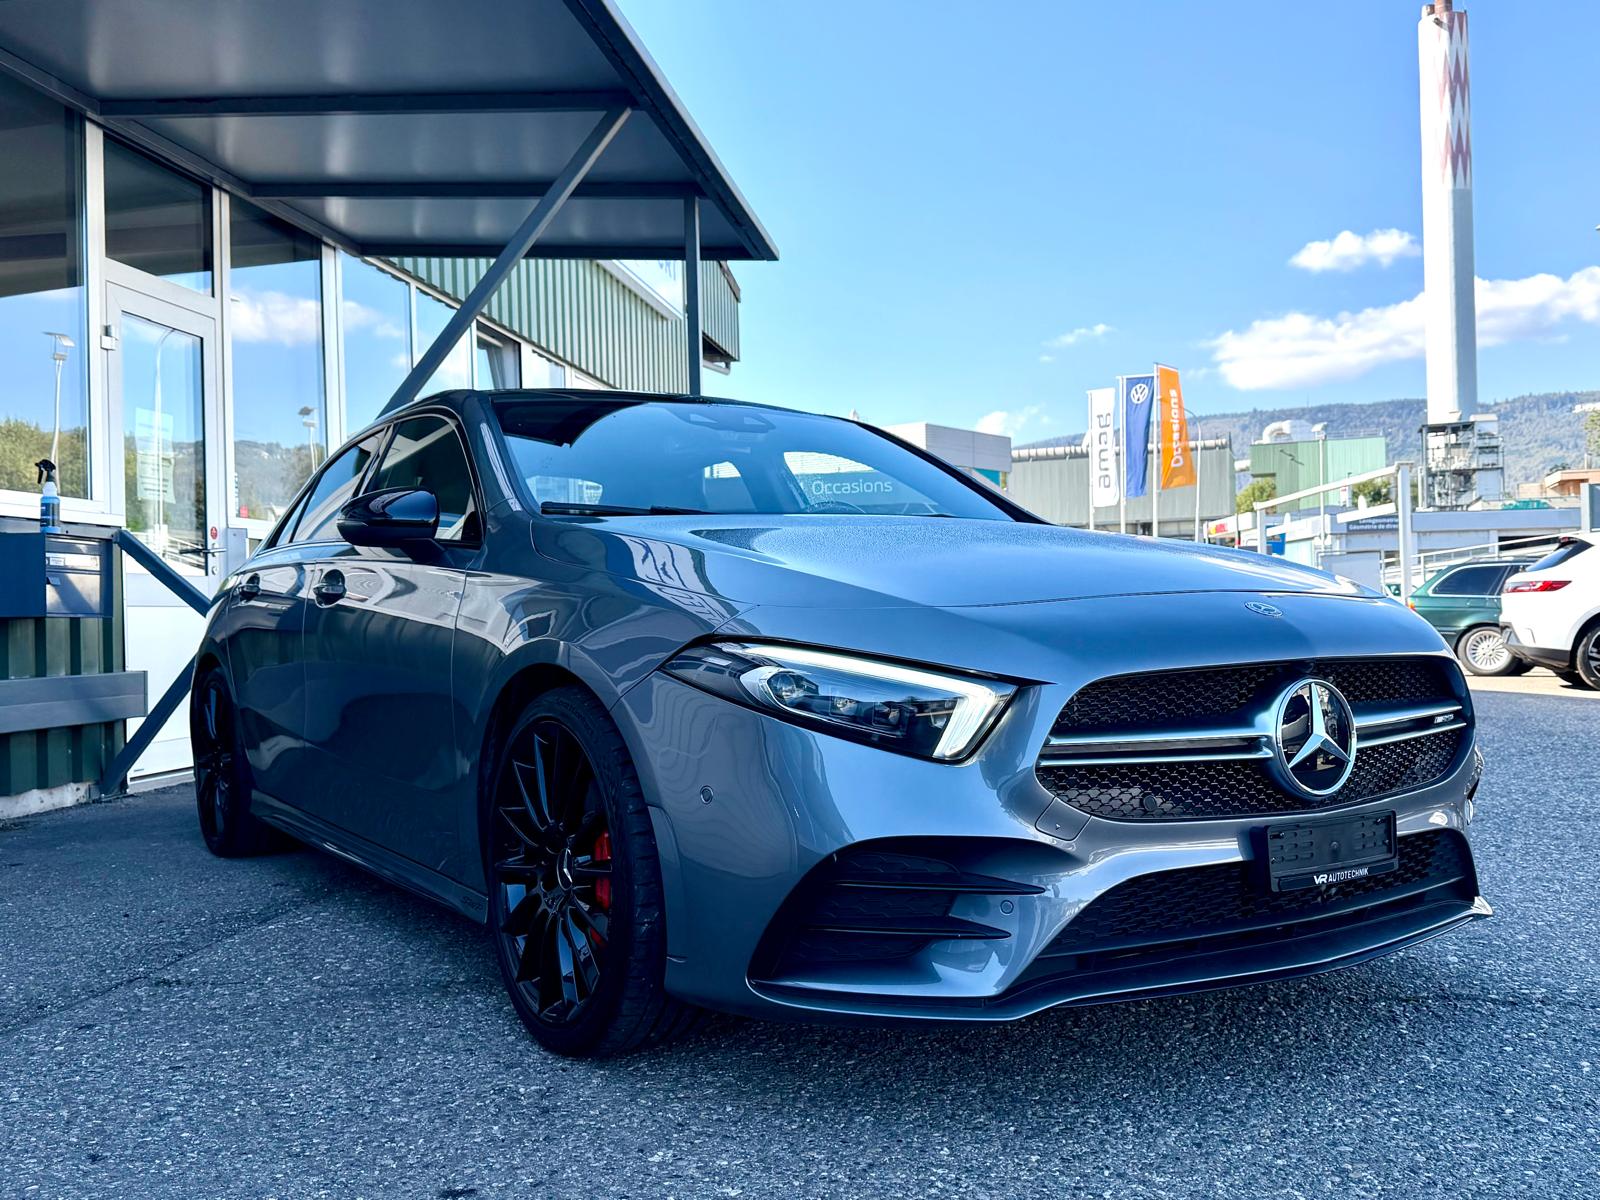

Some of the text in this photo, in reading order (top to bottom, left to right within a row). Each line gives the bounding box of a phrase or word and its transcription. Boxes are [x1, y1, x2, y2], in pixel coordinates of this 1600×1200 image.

[1096, 412, 1111, 489] amag
[812, 479, 893, 495] Occasions
[1328, 866, 1369, 883] AUTOTECHNIK
